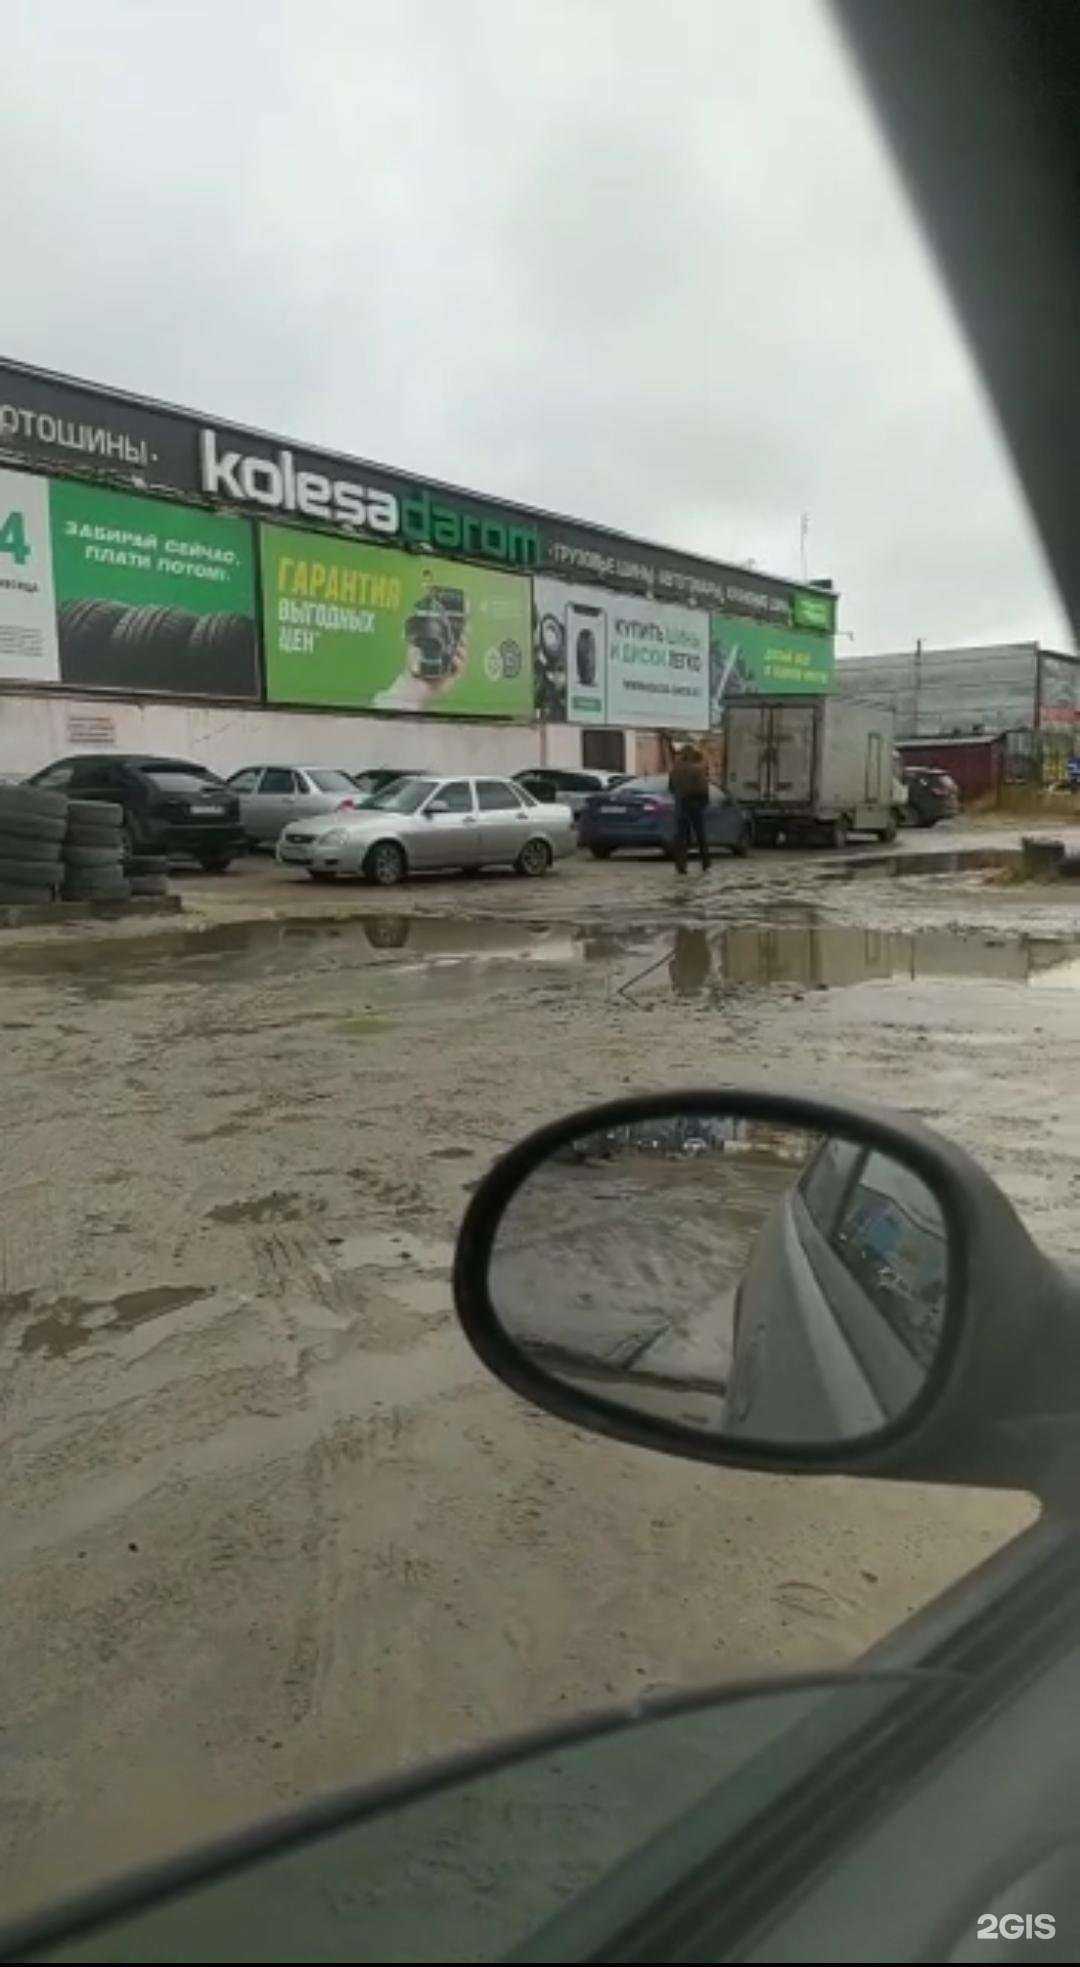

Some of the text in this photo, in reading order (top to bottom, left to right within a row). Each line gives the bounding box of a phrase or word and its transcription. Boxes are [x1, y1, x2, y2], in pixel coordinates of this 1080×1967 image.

[202, 429, 539, 566] kolesadarom
[65, 521, 158, 549] ЗАБИРАЙ
[85, 545, 151, 569] ПЛАТИ
[278, 557, 400, 611] ГАРАНТИЯ
[278, 598, 376, 634] ВЫГОДНЫХ
[615, 618, 664, 642] КУПИТЬ
